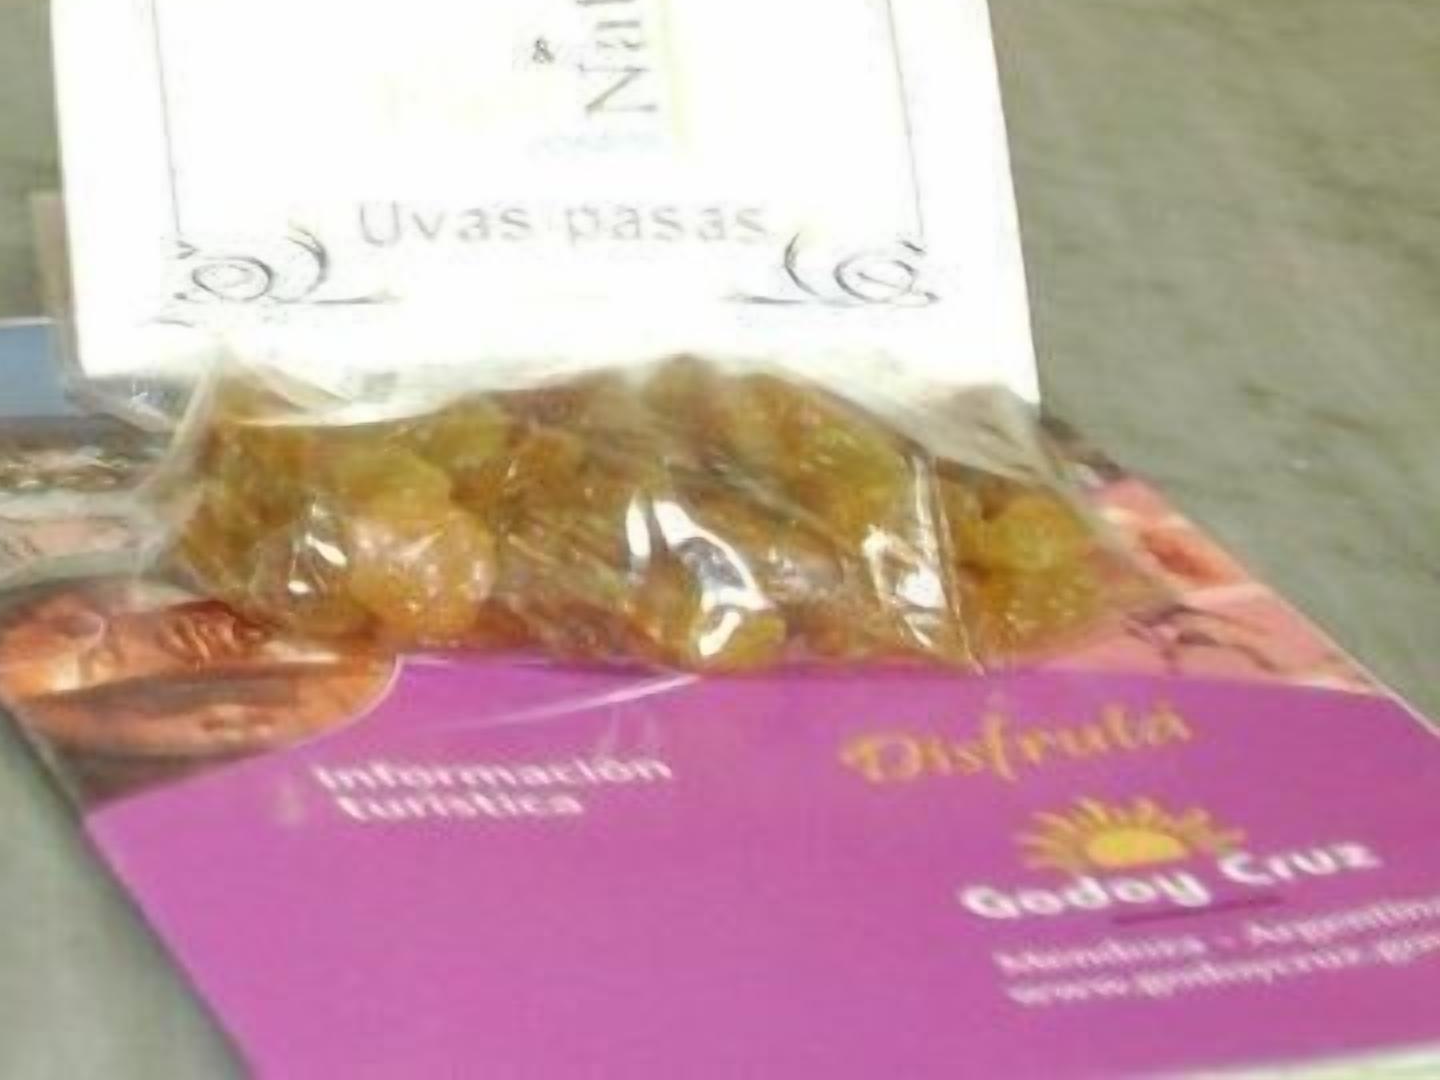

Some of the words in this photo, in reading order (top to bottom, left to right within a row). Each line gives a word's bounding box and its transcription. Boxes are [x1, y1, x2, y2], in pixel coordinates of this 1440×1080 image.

[359, 199, 534, 248] Uvas
[563, 204, 768, 248] pasas
[961, 872, 1212, 919] Godoy
[1217, 841, 1383, 887] Cruz
